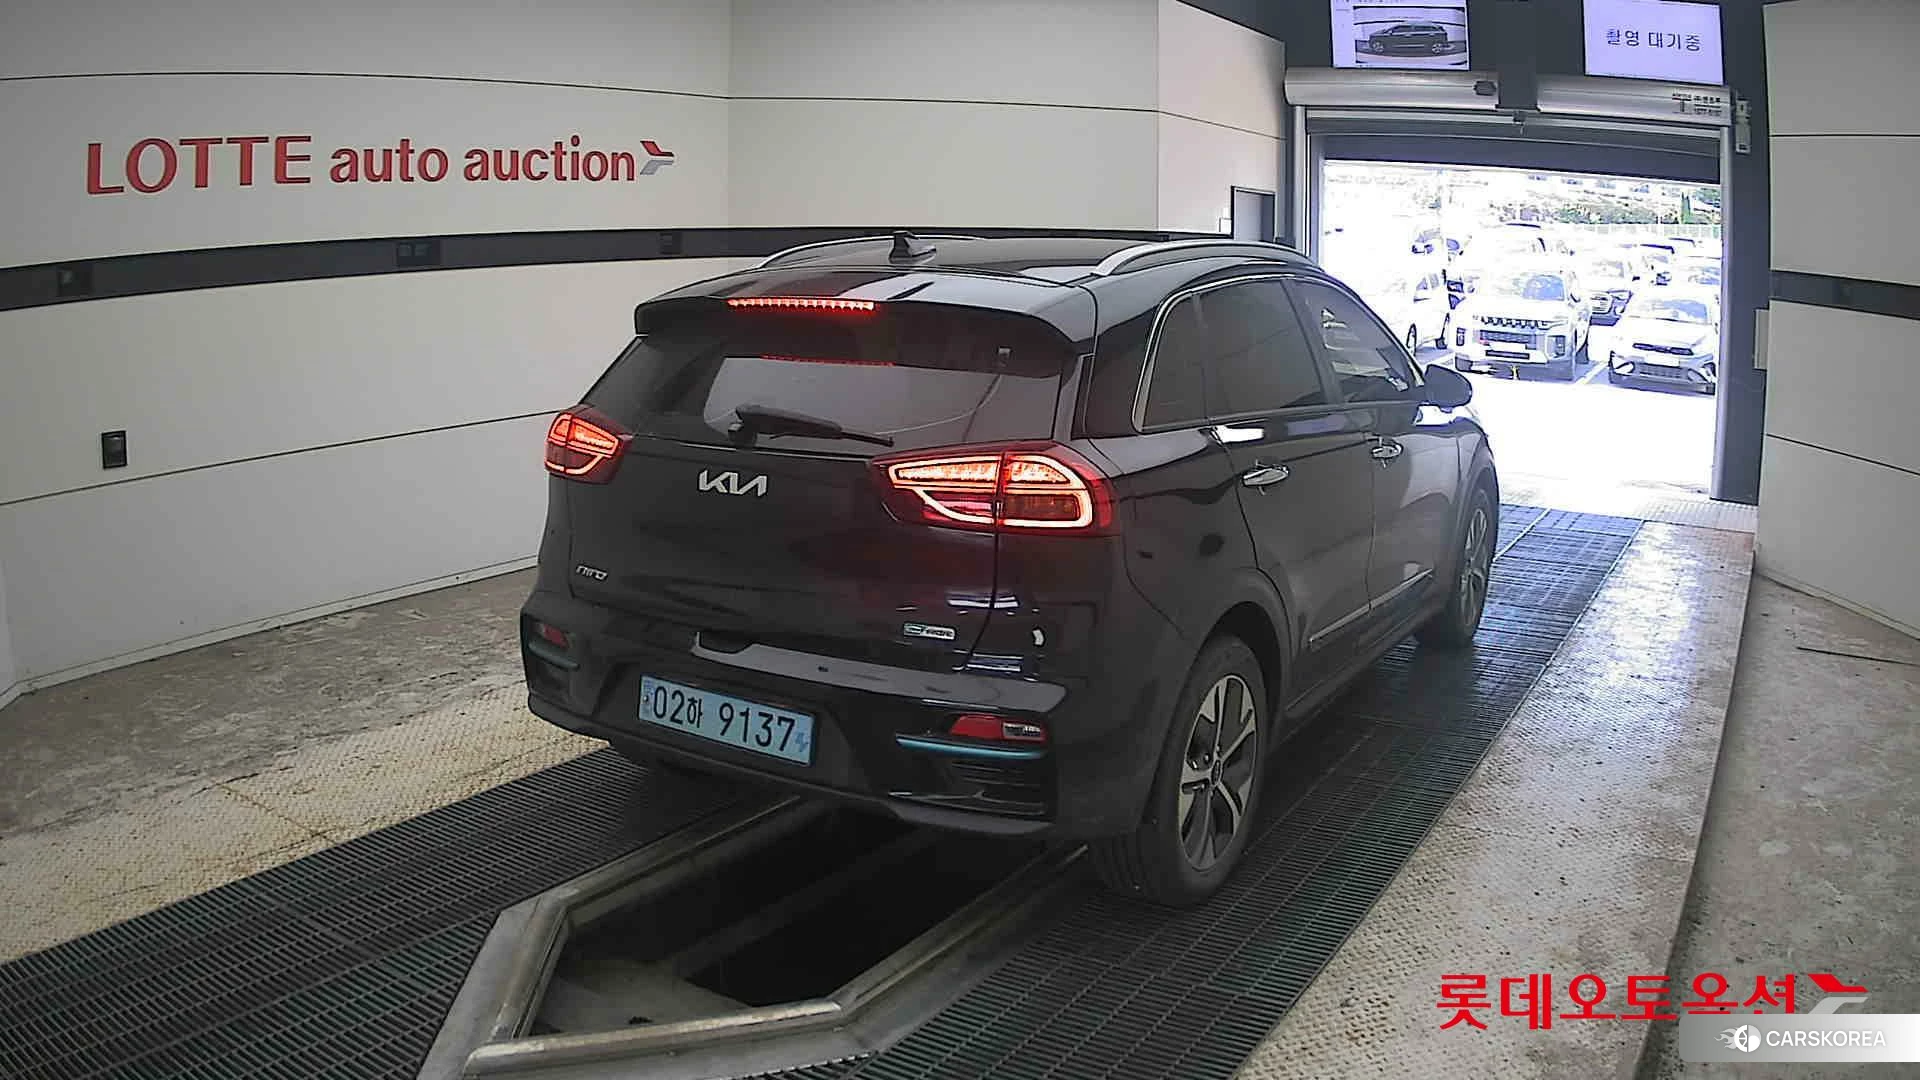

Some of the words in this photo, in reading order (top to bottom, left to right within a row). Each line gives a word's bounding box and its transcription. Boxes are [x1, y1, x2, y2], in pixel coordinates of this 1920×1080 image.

[1648, 32, 1701, 52] 대기중
[87, 135, 312, 195] LOTTE
[329, 138, 449, 183] auto
[463, 134, 635, 182] auction
[698, 469, 768, 497] KIA
[653, 685, 703, 728] 02하
[718, 702, 796, 751] 9137
